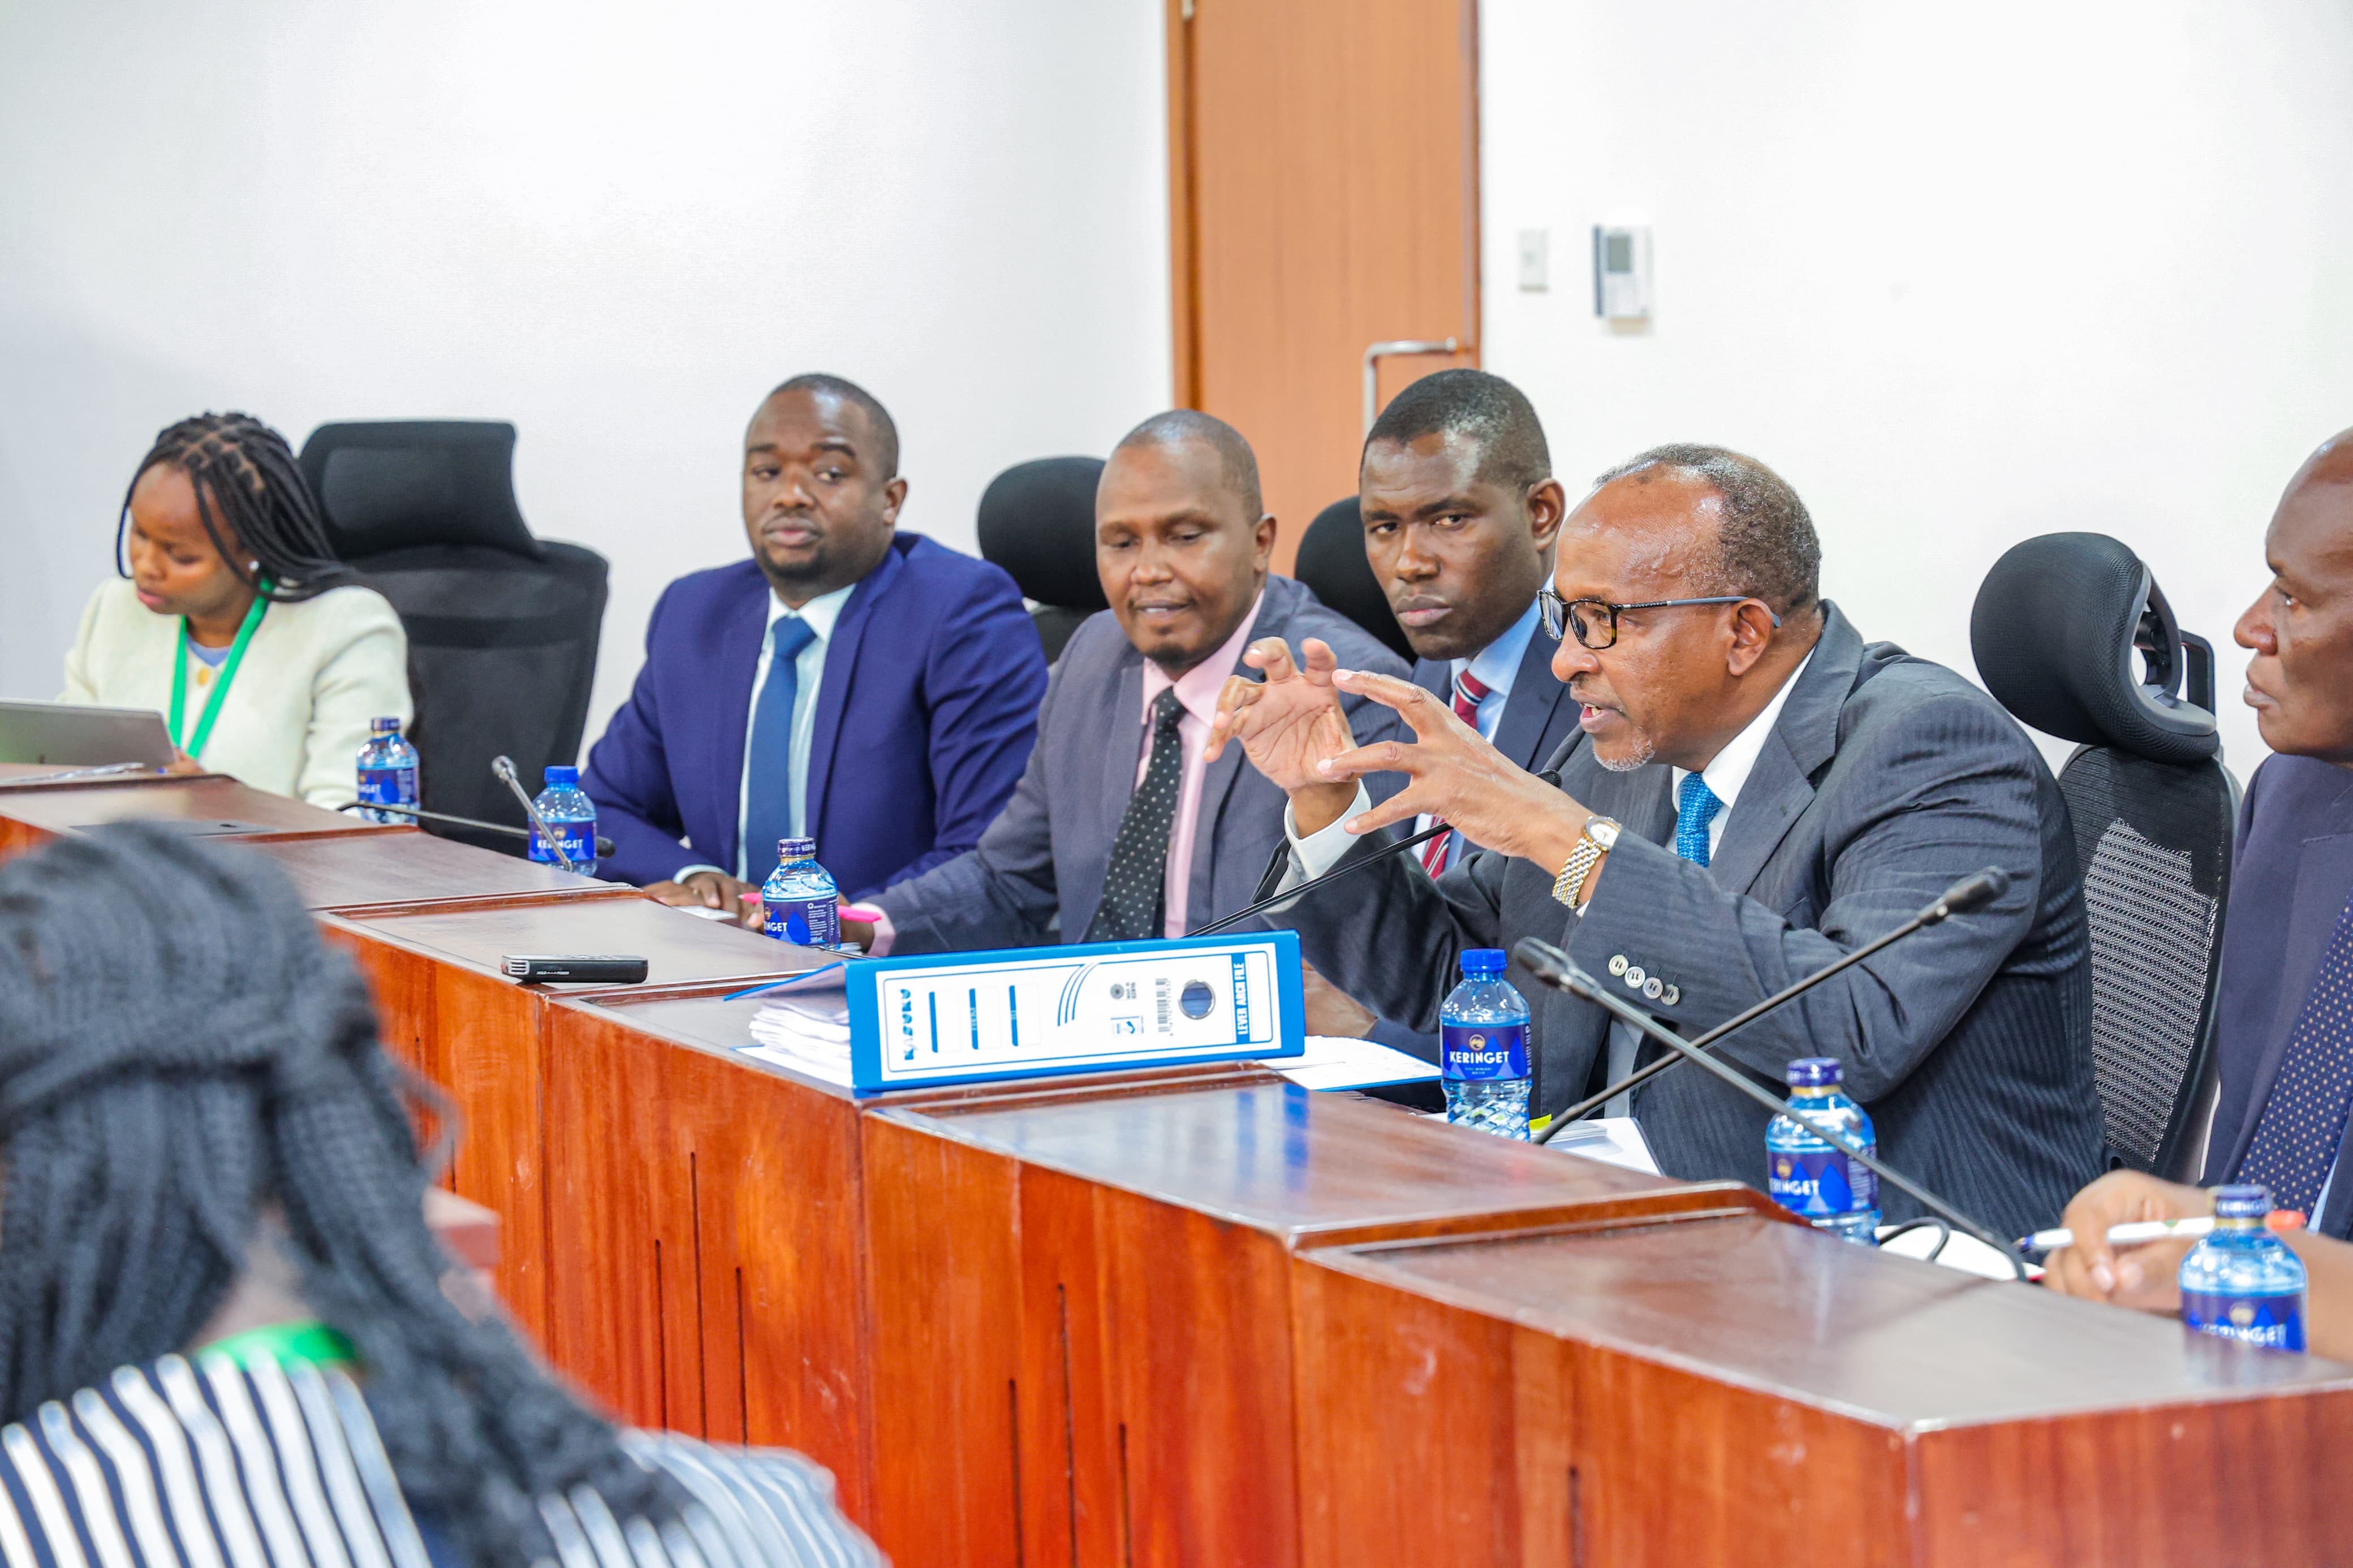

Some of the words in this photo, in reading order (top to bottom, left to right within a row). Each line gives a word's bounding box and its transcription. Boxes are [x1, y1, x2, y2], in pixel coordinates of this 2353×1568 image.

[537, 839, 583, 849] KENGET
[1233, 962, 1246, 980] FILE
[1235, 982, 1247, 1006] ARCH
[1236, 1008, 1249, 1035] LEVER
[1450, 1051, 1509, 1064] KERINGET
